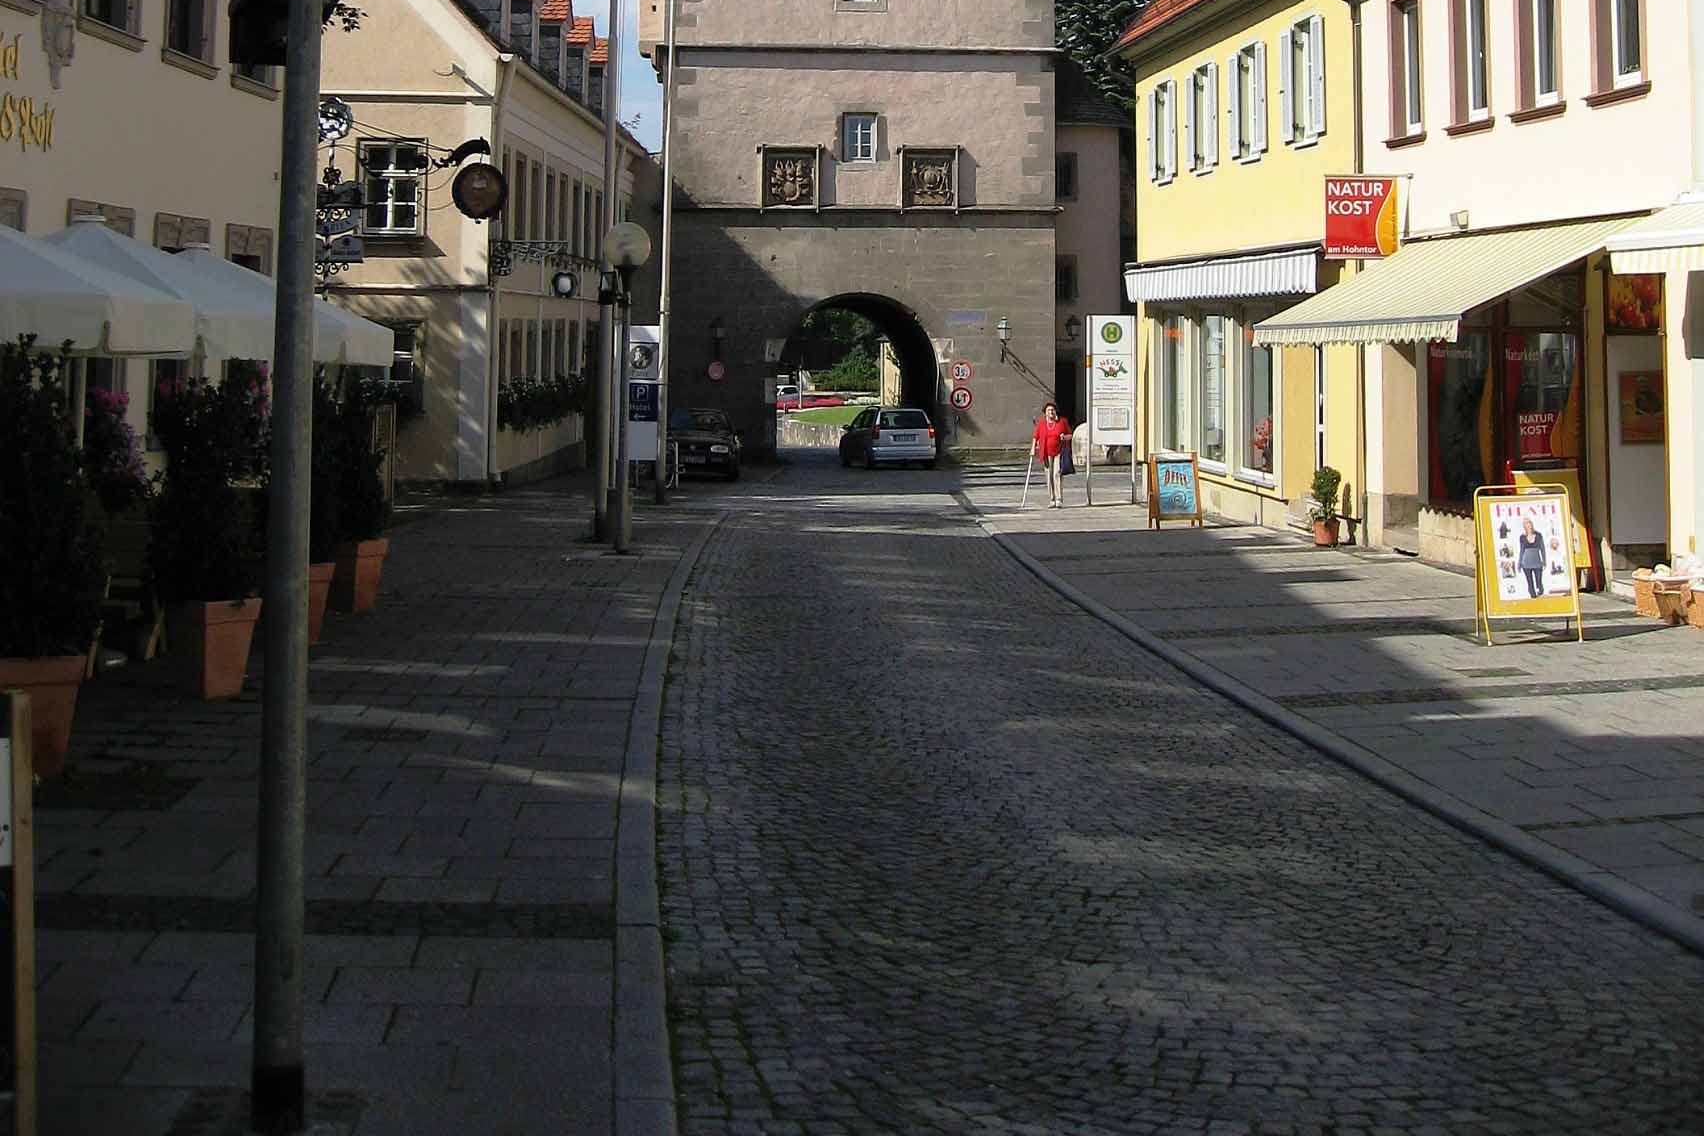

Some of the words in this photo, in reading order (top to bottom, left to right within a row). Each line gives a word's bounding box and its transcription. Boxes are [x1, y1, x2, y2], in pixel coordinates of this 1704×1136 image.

[1327, 181, 1384, 197] NATUR
[1327, 200, 1373, 215] KOST
[1327, 246, 1341, 254] am
[1342, 244, 1377, 254] Hohntor
[1519, 413, 1554, 425] NATUR
[1519, 424, 1549, 436] KOST
